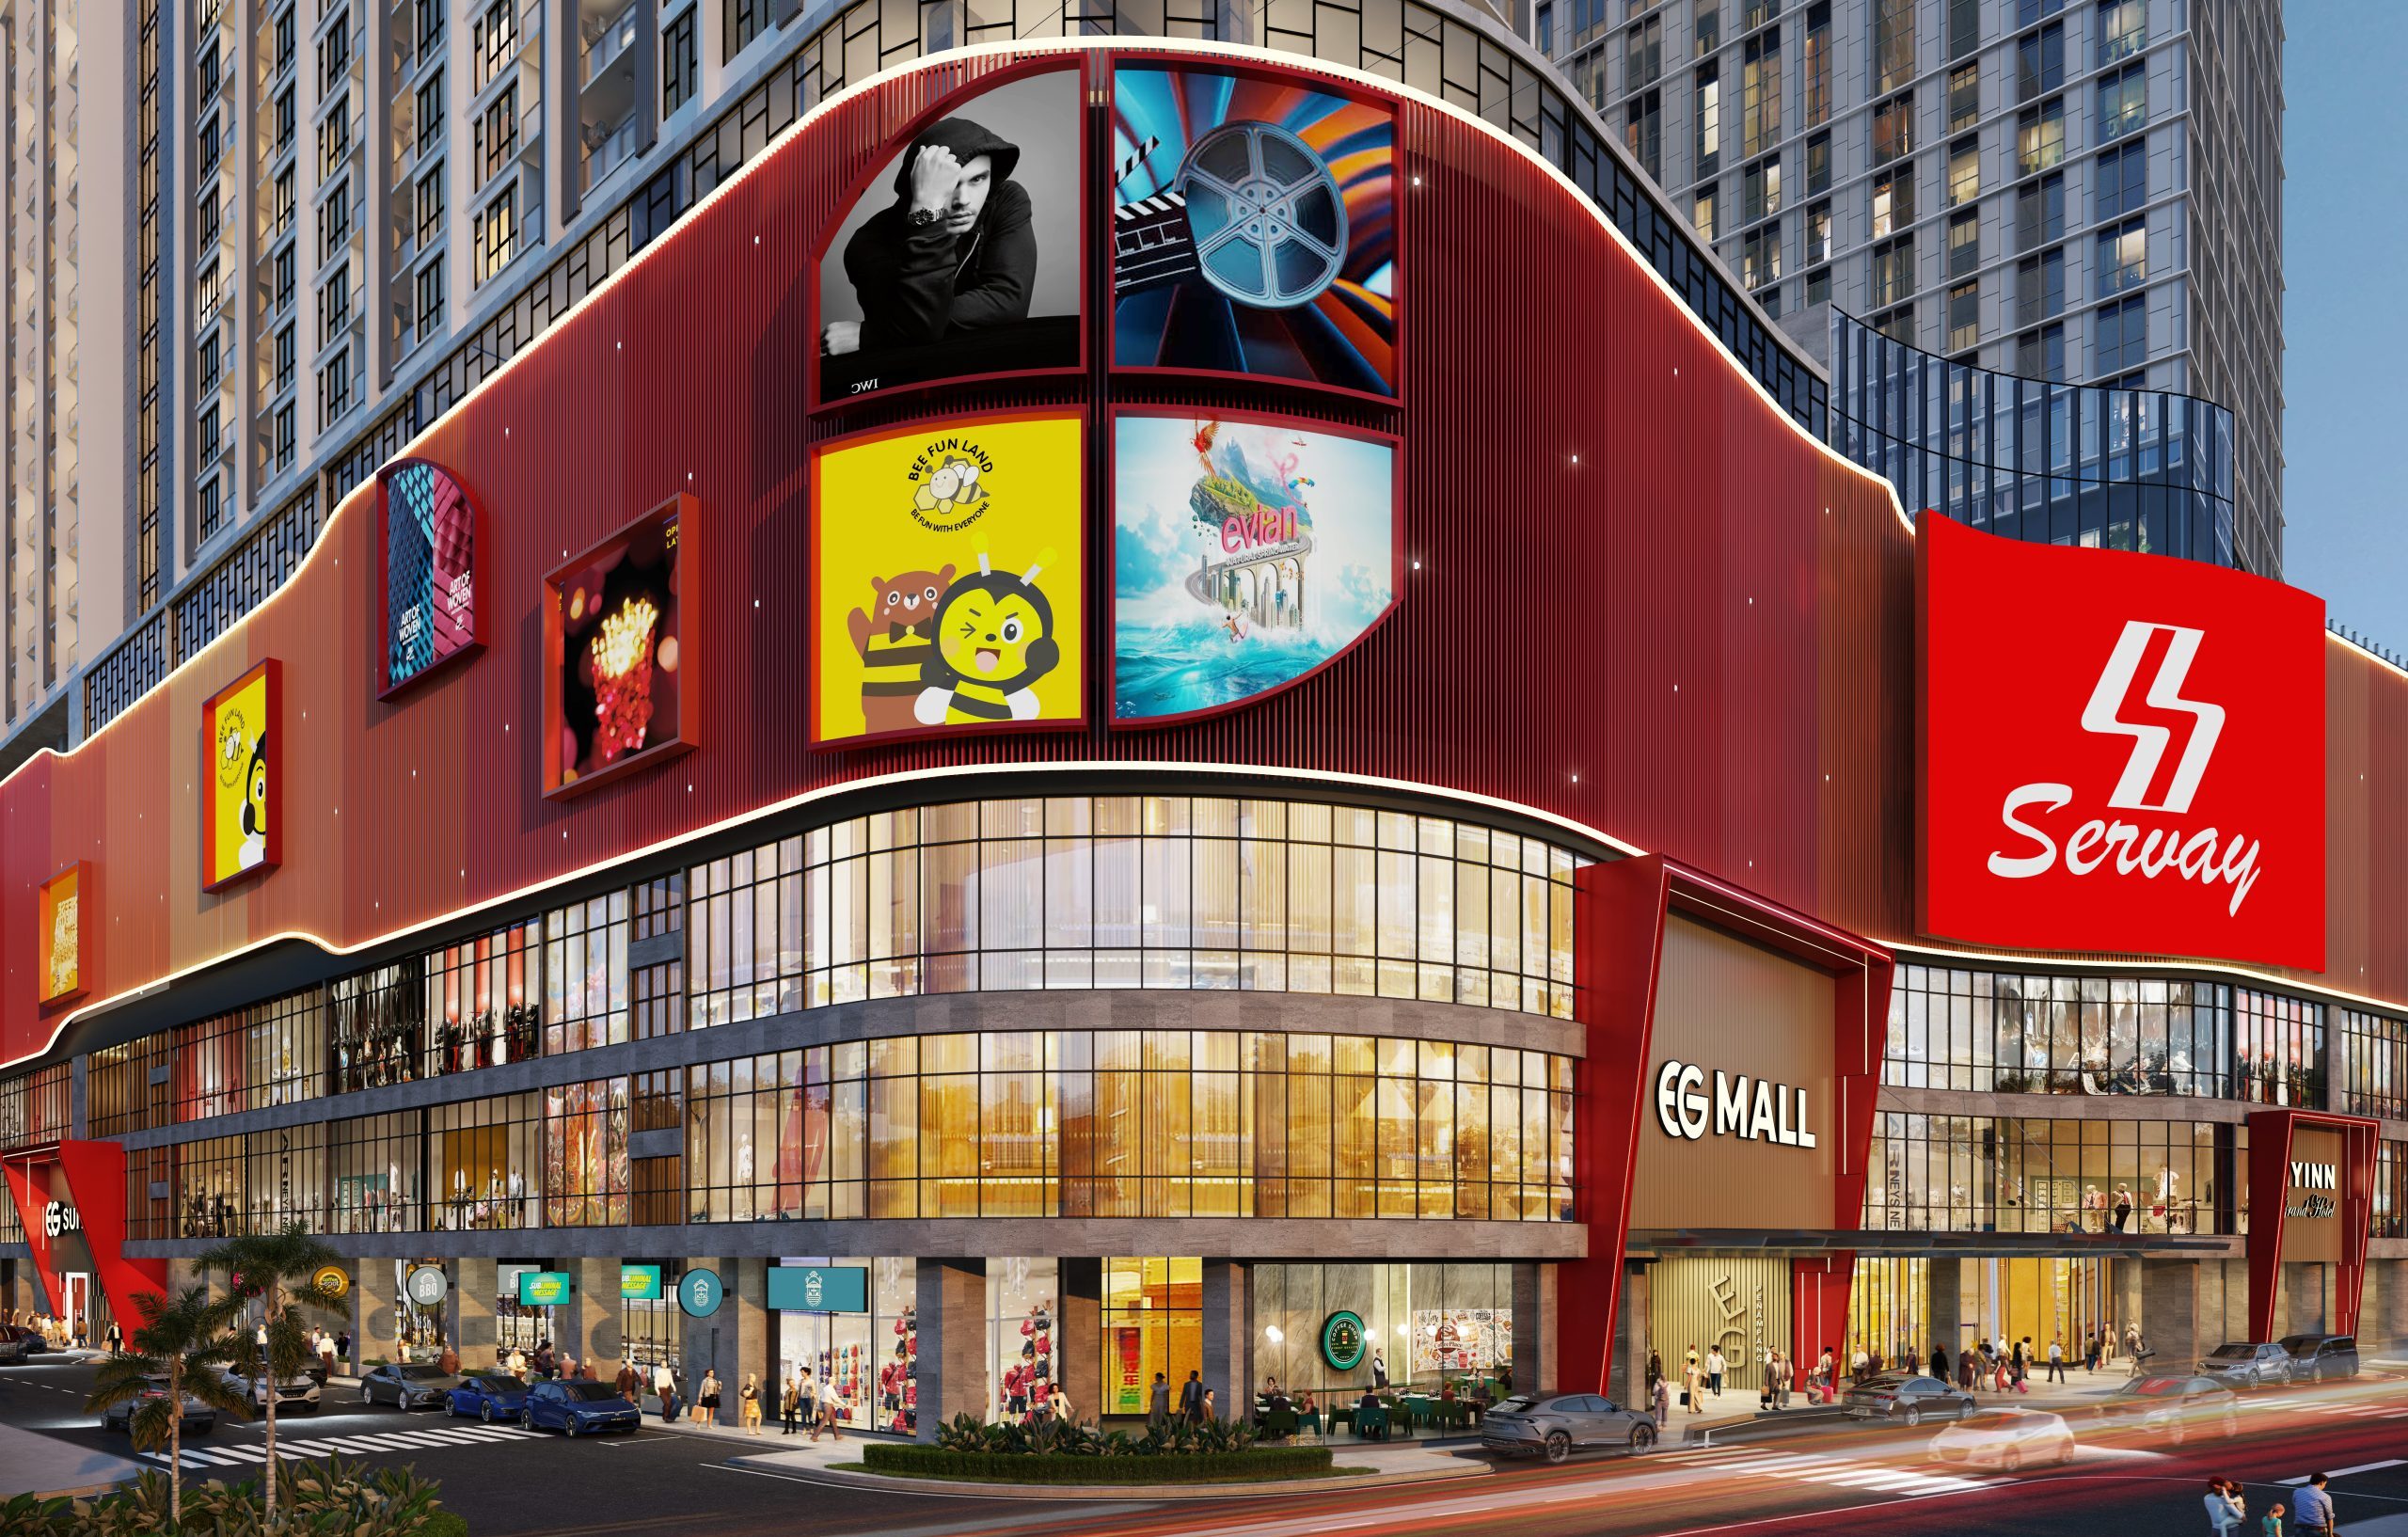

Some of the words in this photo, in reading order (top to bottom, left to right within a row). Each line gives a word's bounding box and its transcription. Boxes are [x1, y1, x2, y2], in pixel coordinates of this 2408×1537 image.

[909, 455, 927, 481] BEE
[927, 438, 958, 457] FUN
[961, 440, 993, 473] LAND
[911, 508, 920, 519] BE
[917, 516, 932, 530] FUN
[933, 524, 953, 532] WITH
[954, 501, 990, 531] EVERYONE
[1222, 502, 1298, 555] evian
[1227, 553, 1258, 566] NATURAL
[1258, 547, 1279, 559] SPRING
[1279, 542, 1300, 554] WATER
[449, 575, 461, 596] ART
[461, 570, 470, 588] OF
[447, 584, 471, 611] WOVEN
[401, 608, 412, 627] ART
[411, 603, 420, 620] OF
[399, 617, 421, 642] WOVEN
[1987, 783, 2261, 918] Servay
[1655, 1059, 1709, 1141] EG
[1713, 1070, 1816, 1149] MALL
[2288, 1162, 2336, 1190] YINN
[46, 1200, 61, 1237] EG
[2308, 1193, 2337, 1219] Hotel
[419, 1282, 437, 1298] BBQ
[1331, 1323, 1347, 1341] COFFEE
[1348, 1323, 1359, 1340] SHOP
[1755, 1285, 1764, 1362] PENAMPANG
